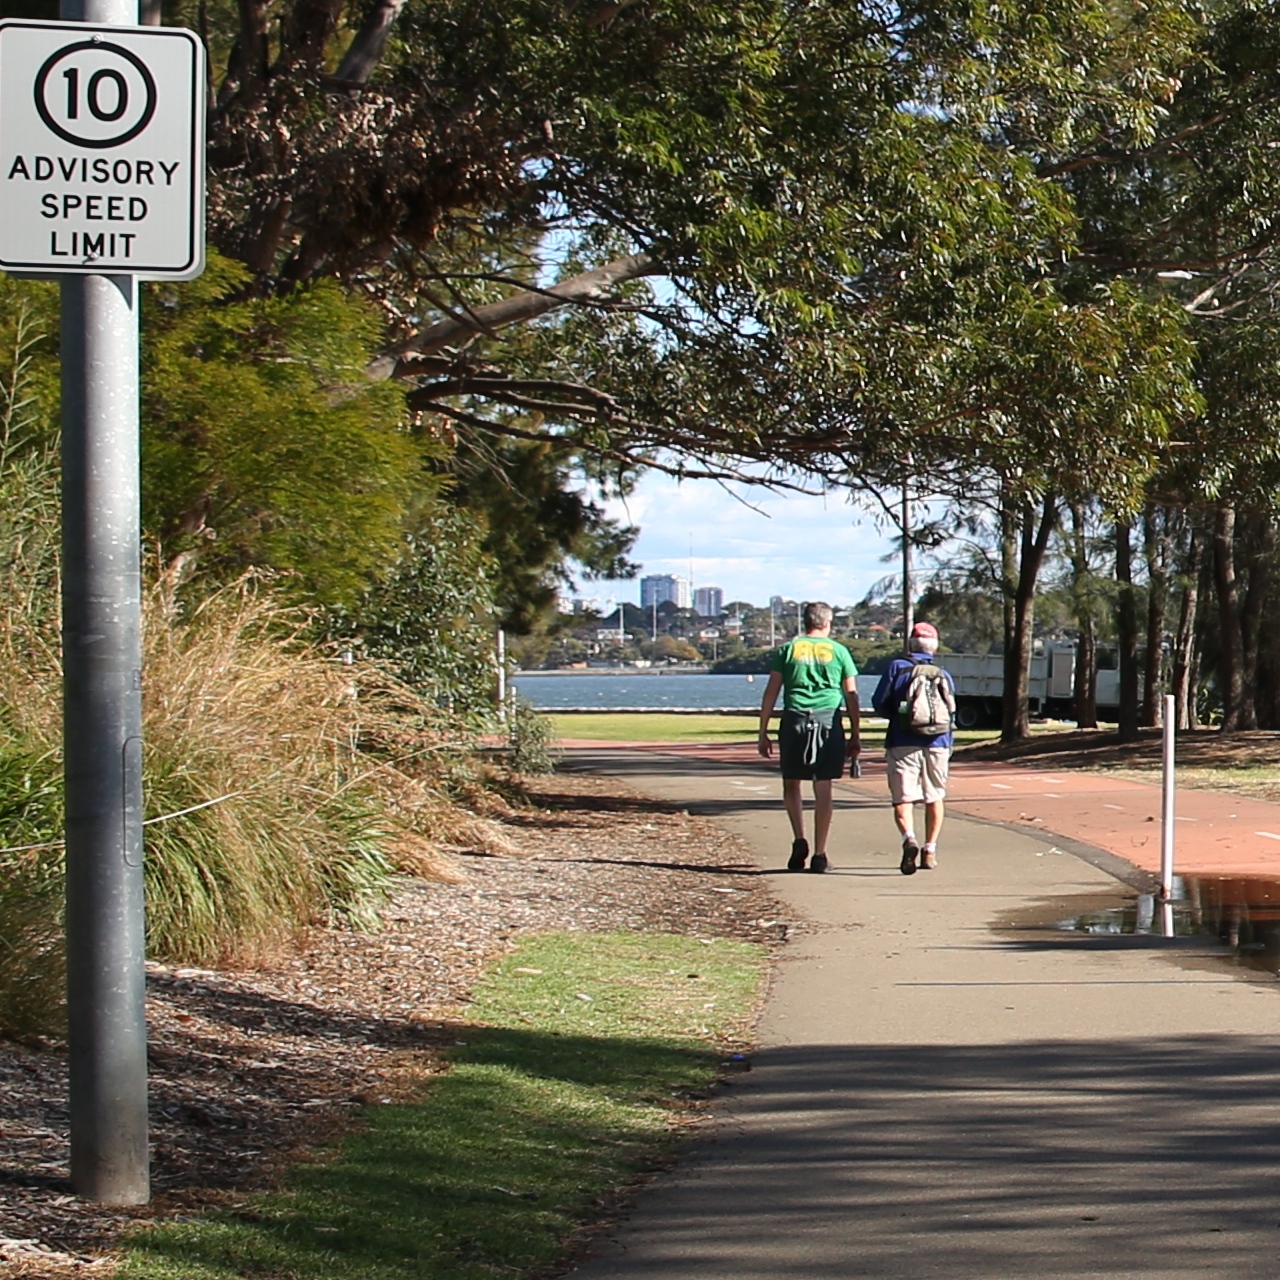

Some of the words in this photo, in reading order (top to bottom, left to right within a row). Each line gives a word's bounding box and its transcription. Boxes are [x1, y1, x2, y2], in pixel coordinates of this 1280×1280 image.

[63, 67, 128, 121] 10
[8, 155, 180, 186] ADVISORY
[40, 193, 148, 221] SPEED
[51, 231, 136, 258] LIMIT
